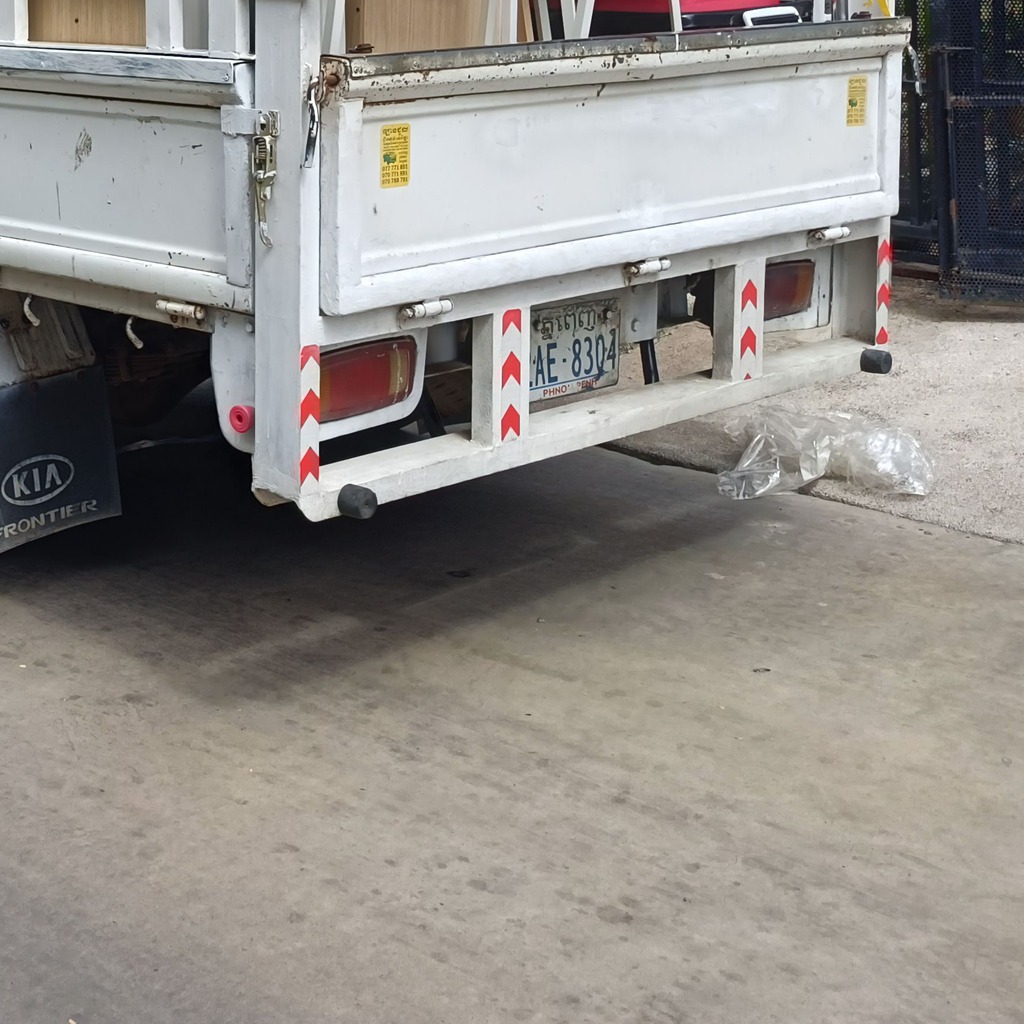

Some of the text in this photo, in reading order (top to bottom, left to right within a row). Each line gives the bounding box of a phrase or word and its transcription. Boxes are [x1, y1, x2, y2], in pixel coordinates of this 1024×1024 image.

[530, 328, 617, 387] AE-8304
[543, 384, 571, 397] PHNO
[11, 463, 63, 498] KIA
